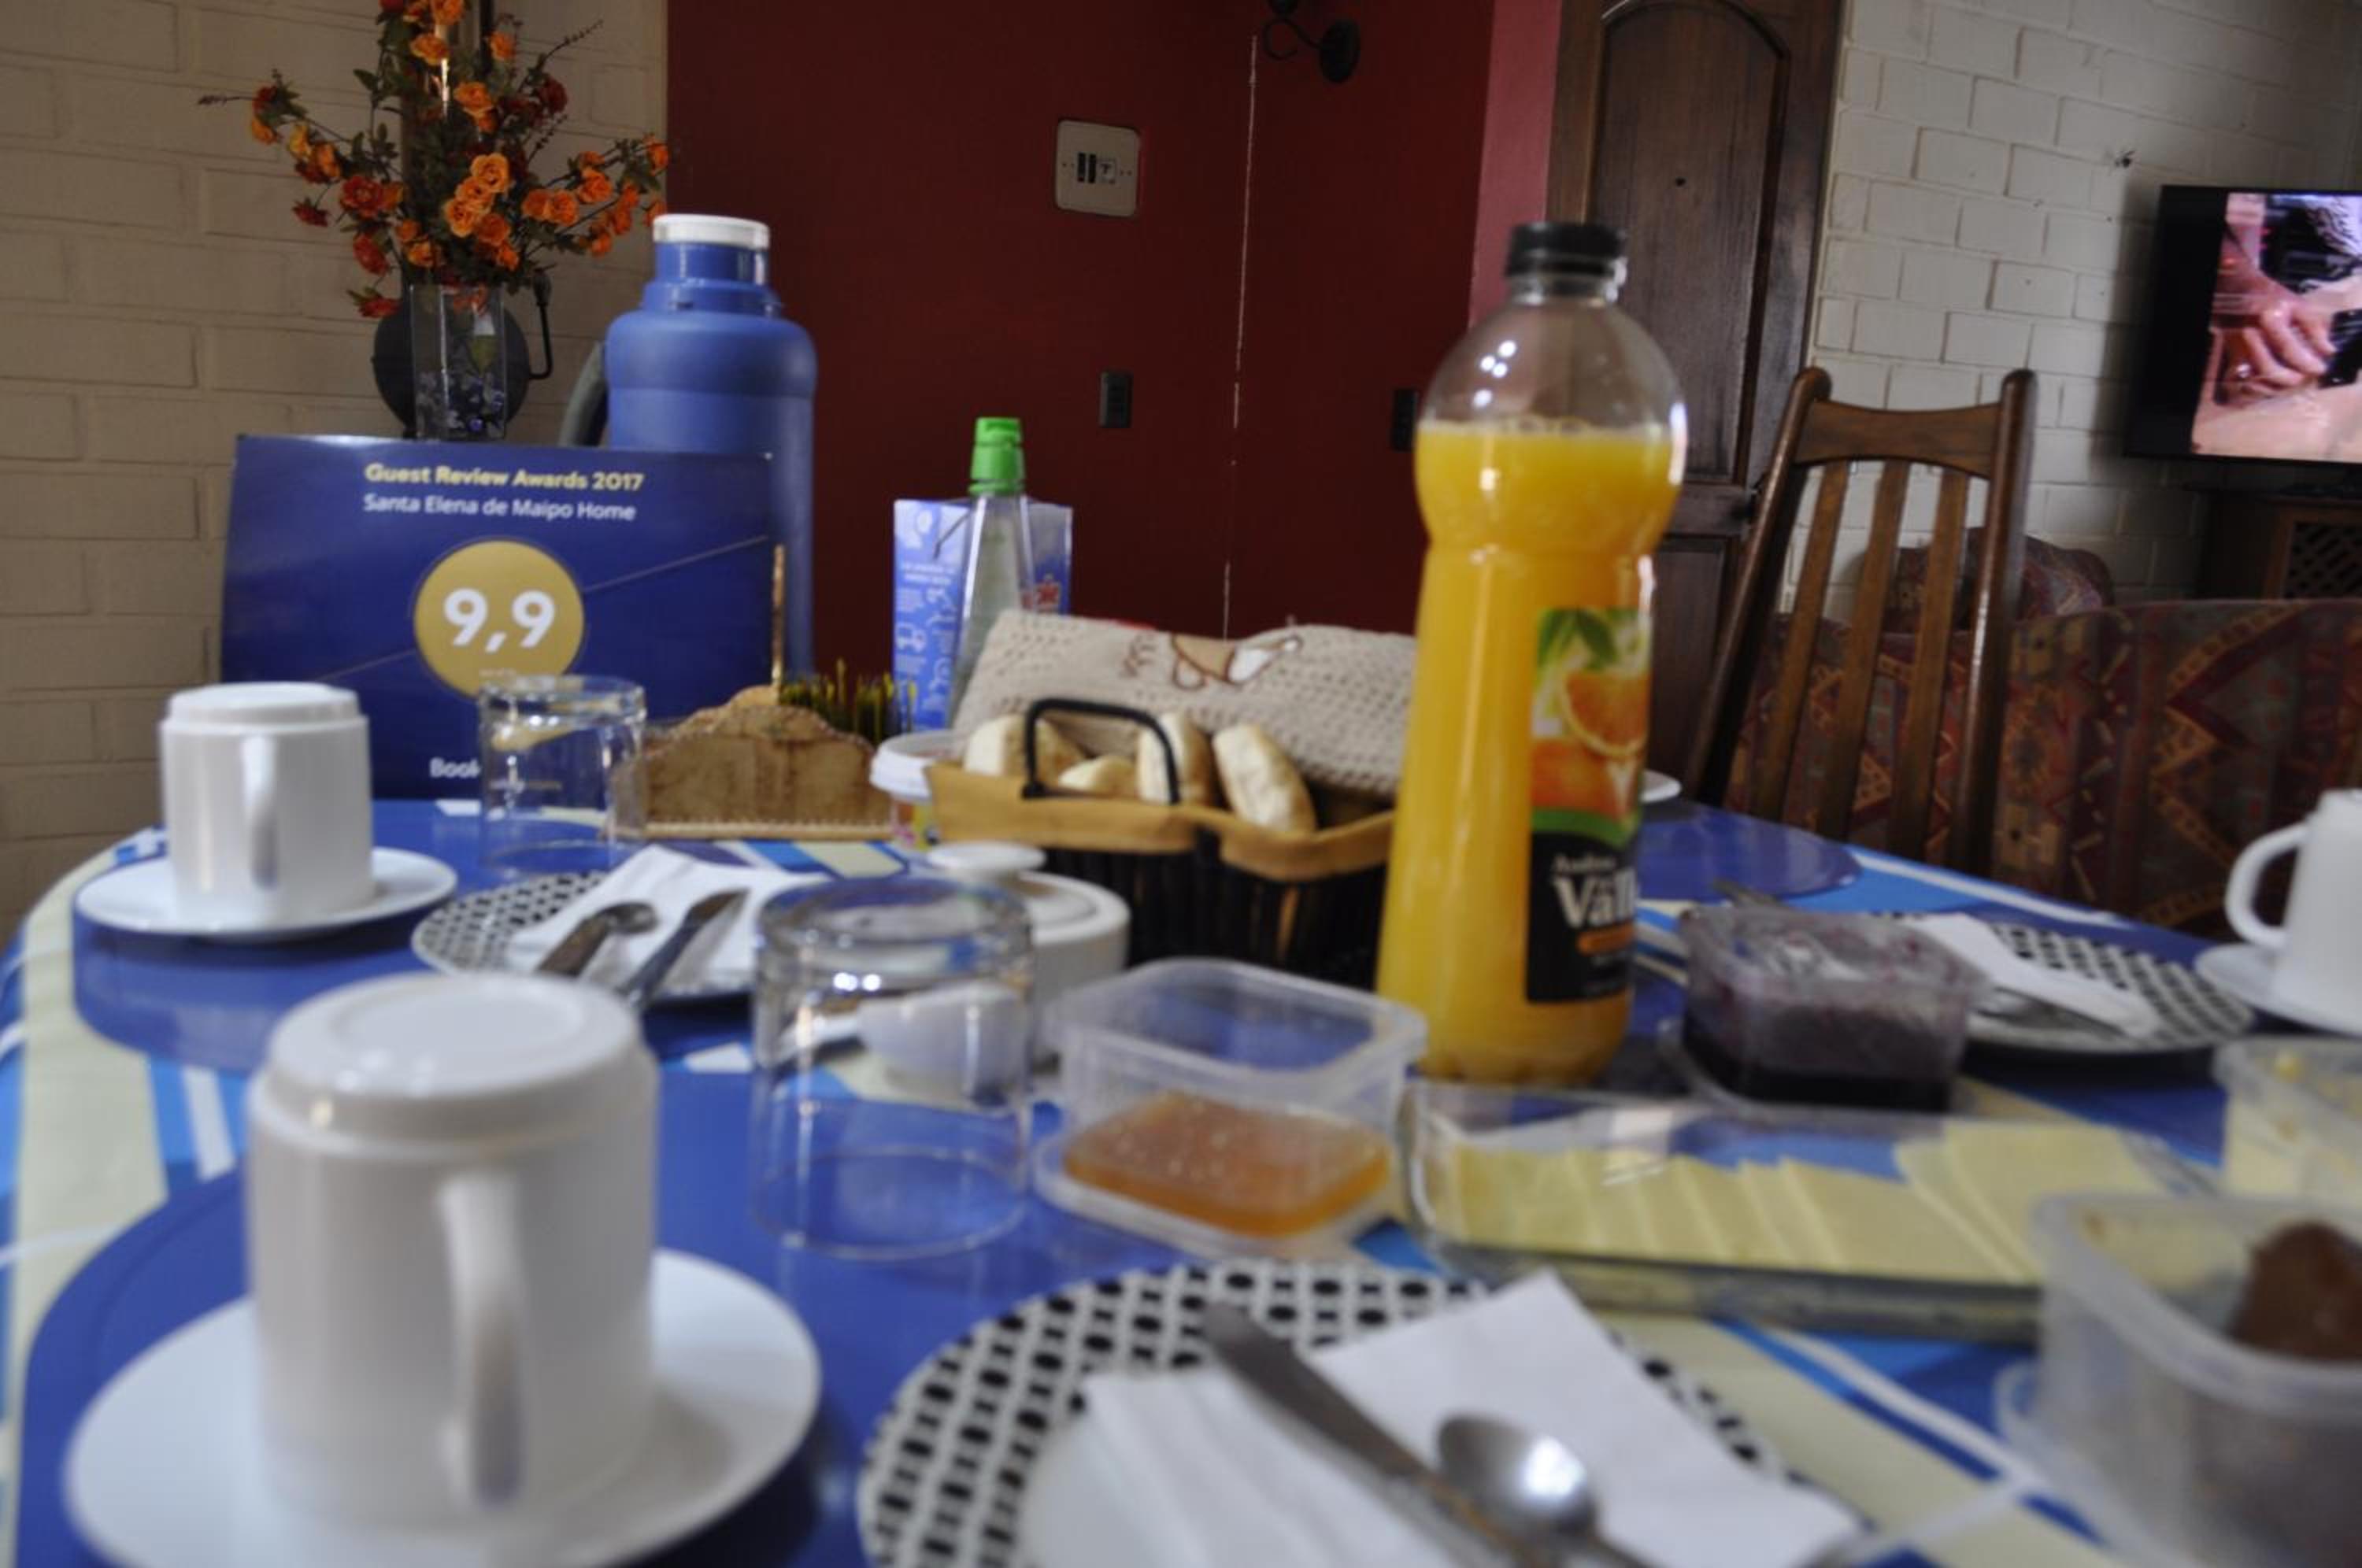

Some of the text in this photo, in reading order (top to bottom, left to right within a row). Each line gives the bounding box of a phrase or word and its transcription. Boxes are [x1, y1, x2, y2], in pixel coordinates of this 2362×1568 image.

[365, 463, 645, 490] Guest Review Awards 2017
[364, 493, 636, 521] Santa Elena de Maipo Home
[444, 589, 555, 653] 9,9
